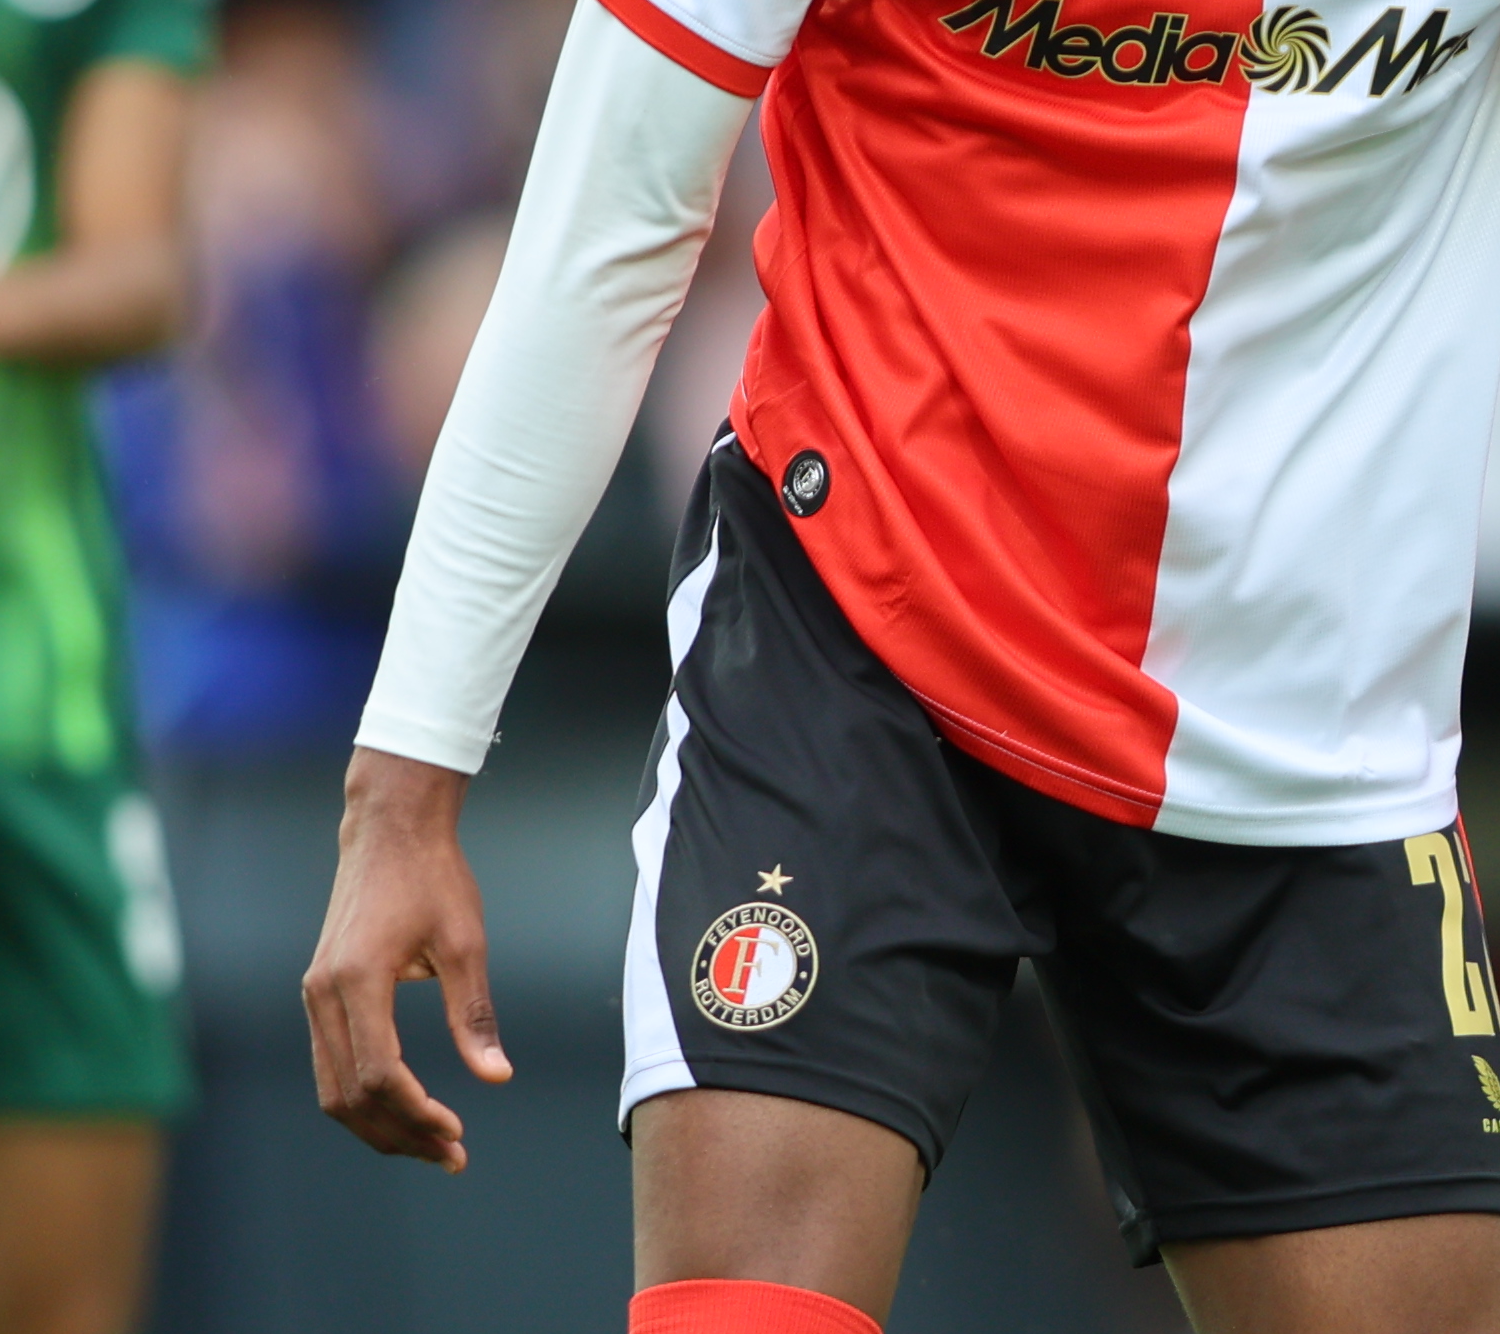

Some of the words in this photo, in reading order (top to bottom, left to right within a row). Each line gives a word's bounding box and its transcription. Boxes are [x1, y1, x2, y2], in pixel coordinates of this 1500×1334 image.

[707, 908, 811, 956] FEYENOORD
[722, 935, 780, 994] F
[695, 977, 803, 1025] ROTTERDAM
